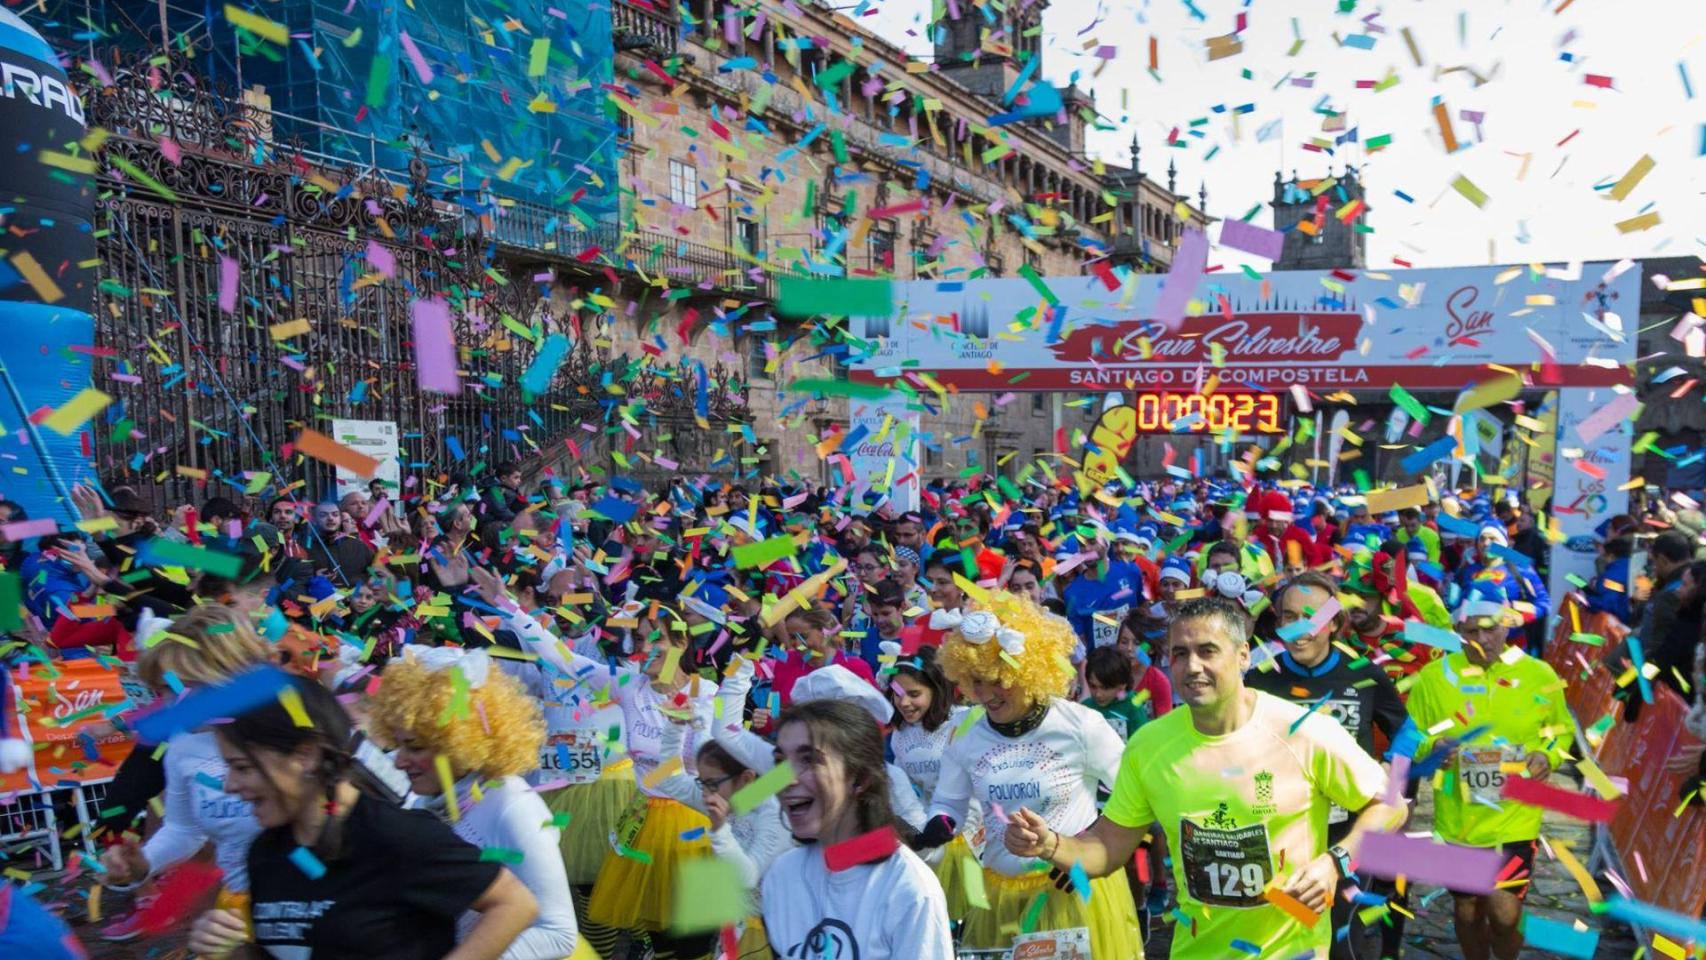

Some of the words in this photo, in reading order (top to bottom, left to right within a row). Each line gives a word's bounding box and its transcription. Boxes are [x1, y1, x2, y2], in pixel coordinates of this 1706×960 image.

[0, 62, 87, 128] RAD
[1445, 286, 1495, 338] San
[1121, 322, 1196, 361] San
[1202, 320, 1342, 361] Silvestre
[1069, 369, 1174, 385] SANTIAGO
[1182, 369, 1210, 384] DE
[1218, 367, 1369, 384] COMPOSTELA
[1201, 837, 1239, 849] SANTIAGO
[1204, 862, 1264, 897] 129
